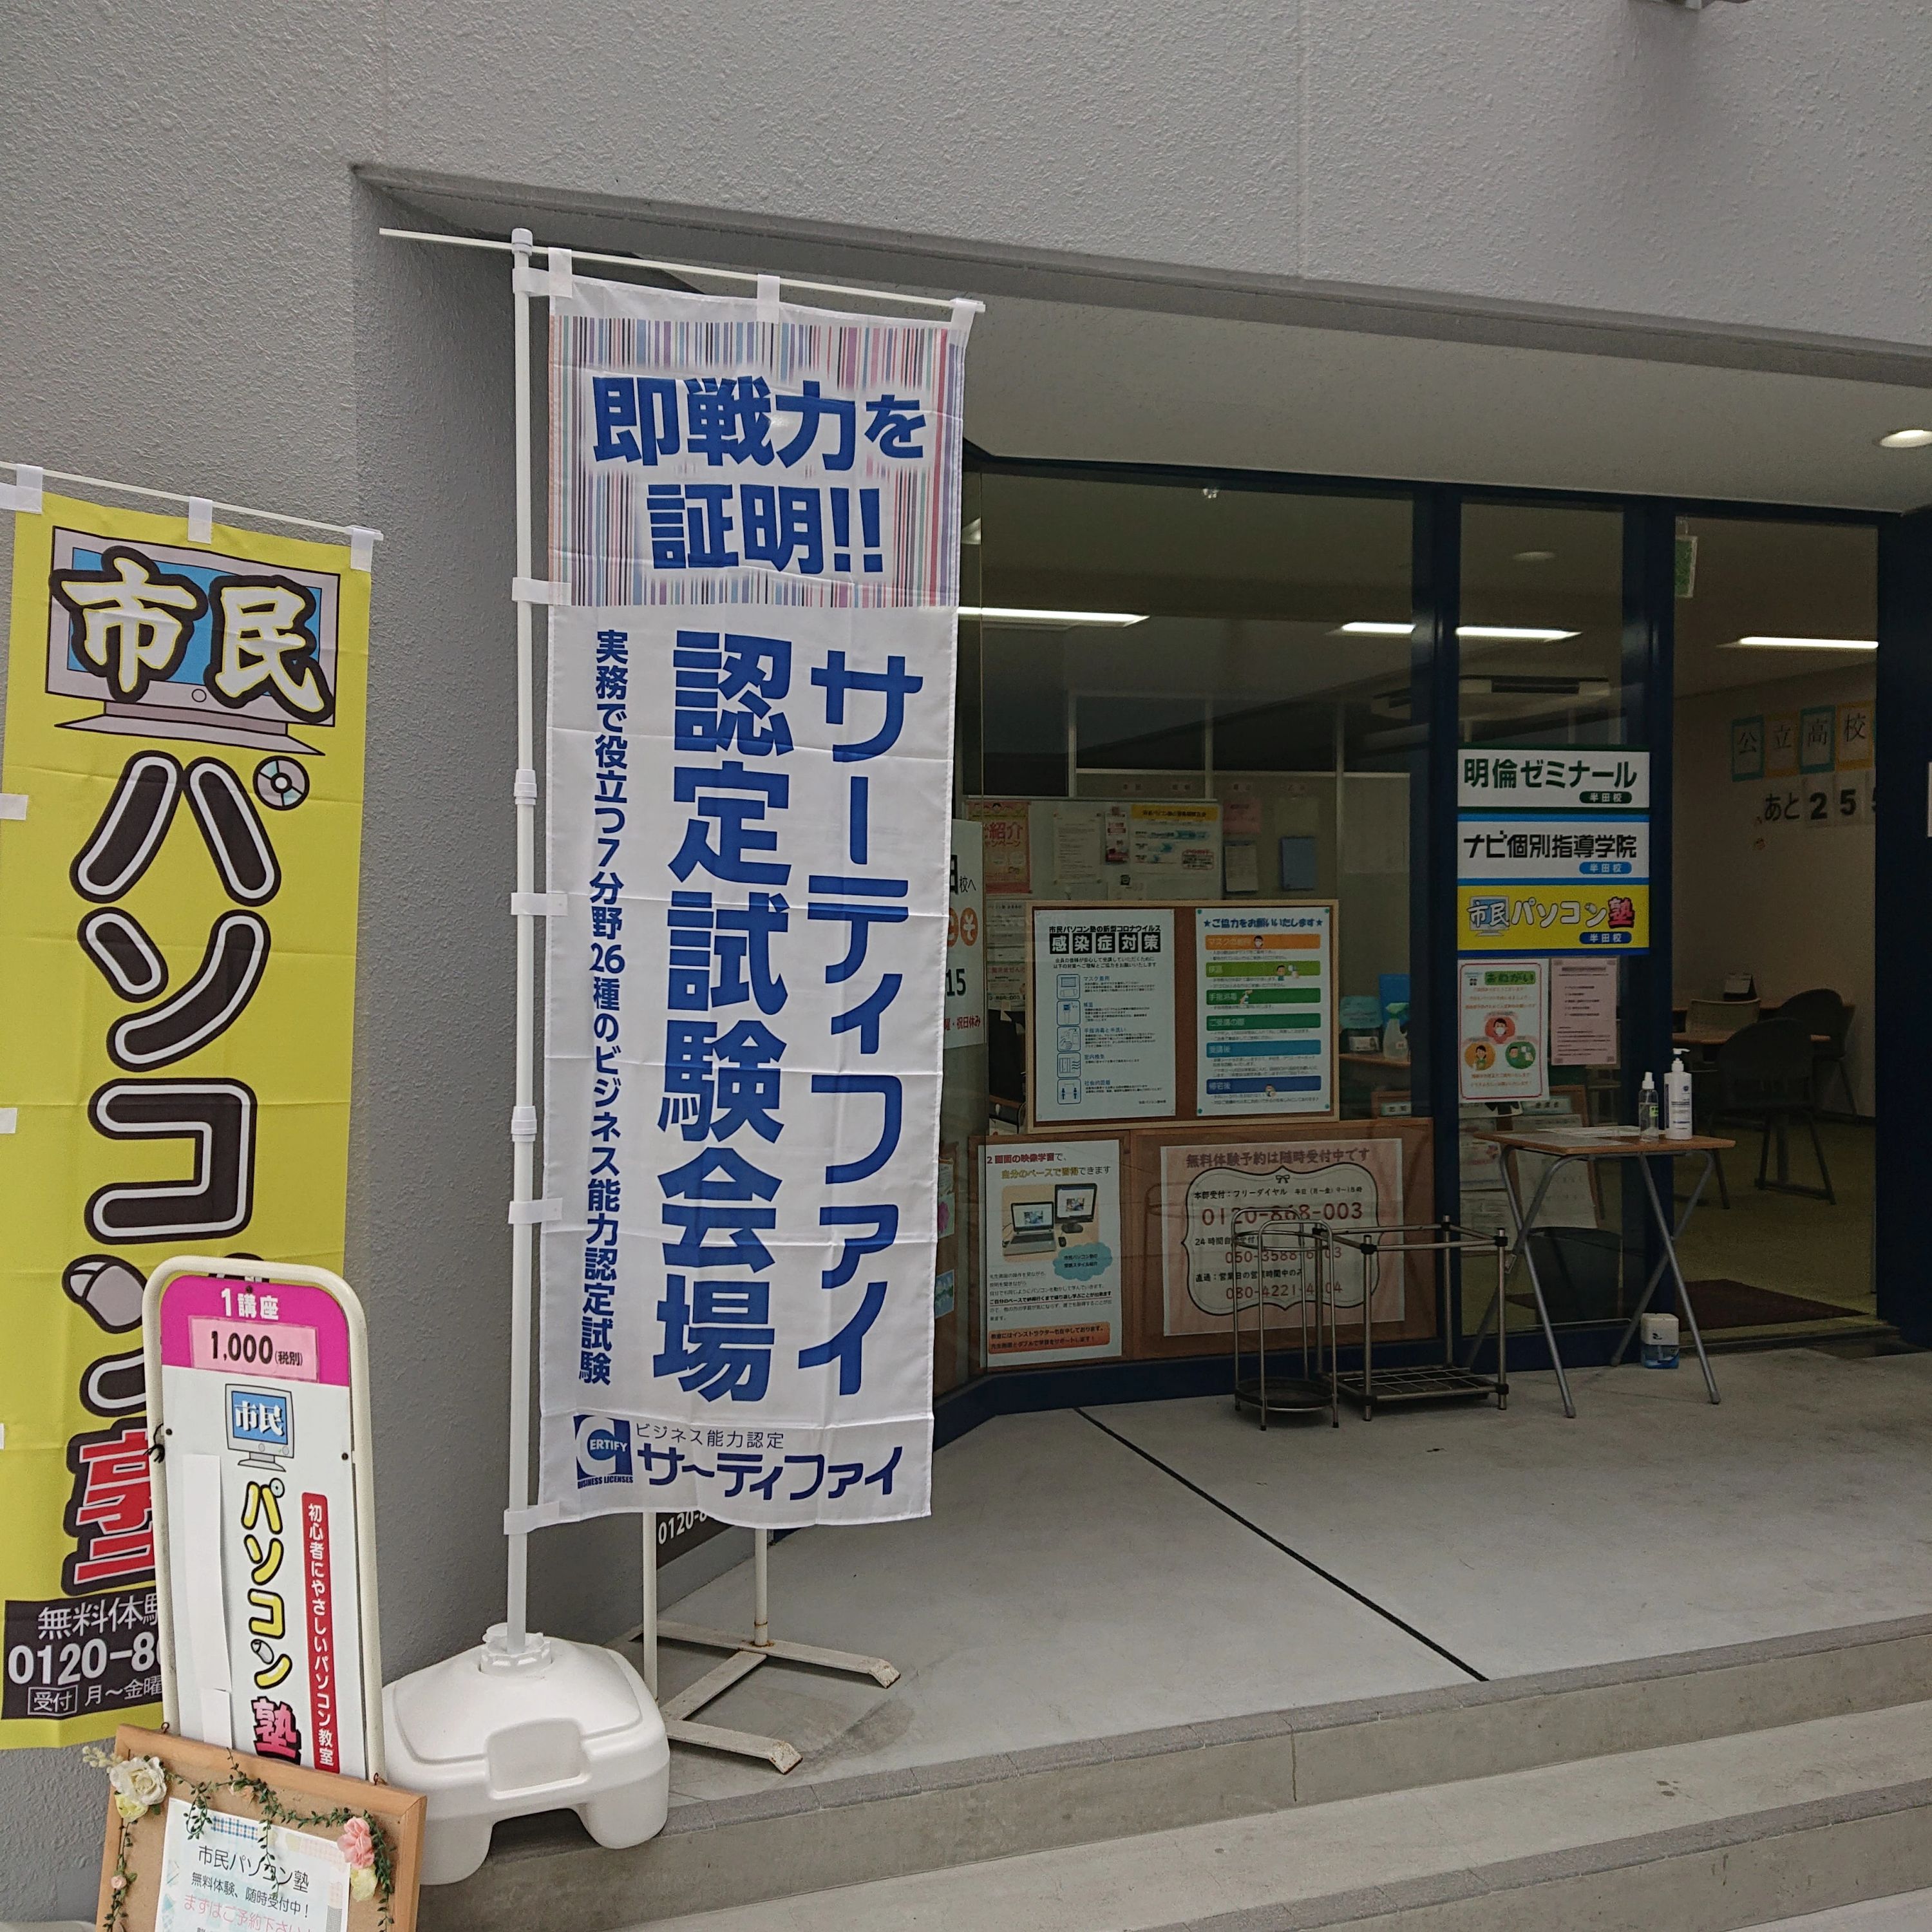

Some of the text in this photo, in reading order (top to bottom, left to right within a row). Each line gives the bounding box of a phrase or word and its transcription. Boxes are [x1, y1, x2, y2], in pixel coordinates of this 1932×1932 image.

[592, 375, 926, 471] 即戦力を
[50, 546, 334, 723] 市民
[1739, 714, 1866, 754] 公立高校
[1464, 758, 1637, 788] 明倫ゼミナール
[1589, 793, 1623, 803] 半田校
[1464, 830, 1636, 858] ナビ個別指導学院
[1589, 863, 1623, 873] 半田校
[1467, 896, 1636, 929] 市民パソコン塾
[1050, 933, 1160, 954] 感染症対策
[1589, 933, 1623, 943] 半田校
[653, 630, 794, 1403] 認定試験会場
[798, 650, 923, 1396] サーティファイ
[1186, 1148, 1370, 1168] 無料体験予約は随時受付中です
[221, 1288, 279, 1320] 1講座
[234, 1401, 285, 1436] 市民
[636, 1422, 784, 1449] ビジネス能力認定
[604, 1475, 634, 1484] LICENSES
[242, 1478, 301, 1765] パソコン塾
[308, 1503, 336, 1766] 初心者にやさしいパソコン教室
[8, 1631, 161, 1685] 0120-8
[33, 1692, 72, 1712] 受付
[198, 1846, 309, 1893] 市民パソコン塾
[184, 1895, 311, 1932] まずはご予約下さ
